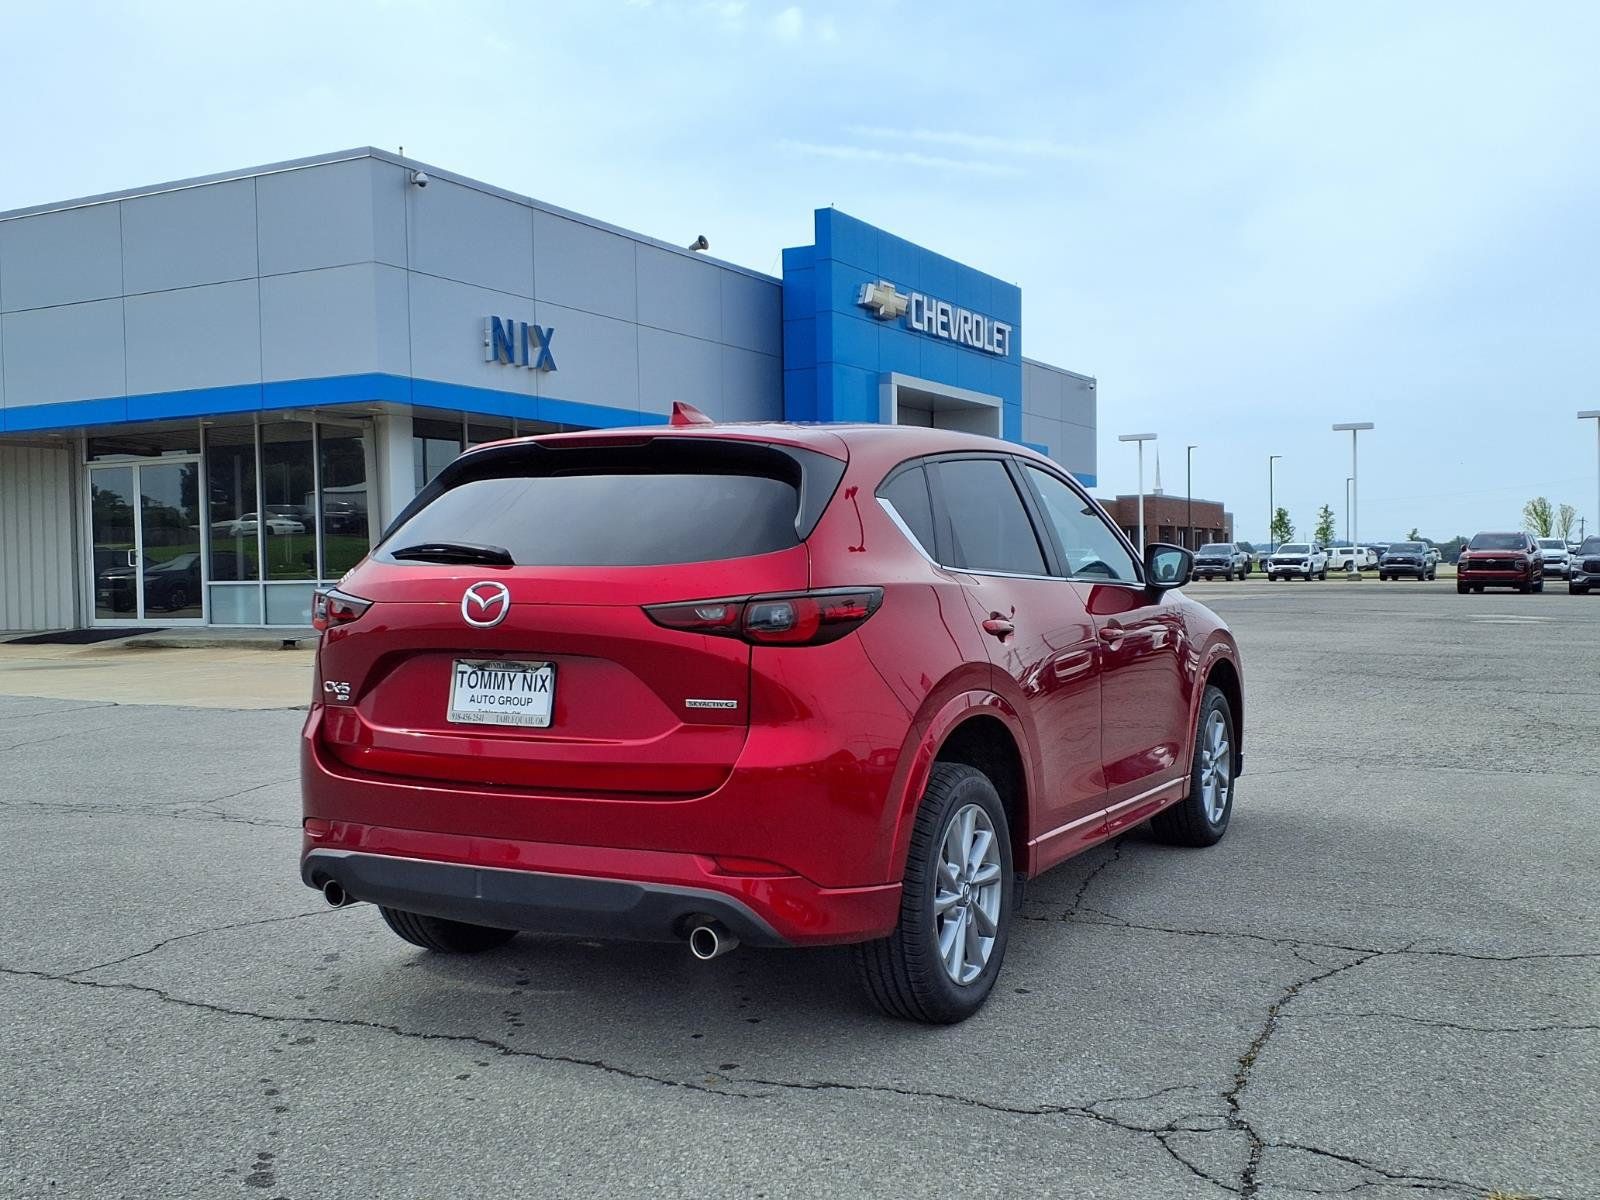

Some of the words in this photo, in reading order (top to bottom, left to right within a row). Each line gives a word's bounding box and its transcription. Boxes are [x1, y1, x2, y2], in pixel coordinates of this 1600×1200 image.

[485, 315, 557, 371] NIX
[910, 292, 1012, 356] CHEVROLET
[458, 670, 517, 691] TOMMY
[521, 673, 549, 693] NIX
[469, 694, 496, 705] AUTO
[497, 695, 533, 707] GROUP
